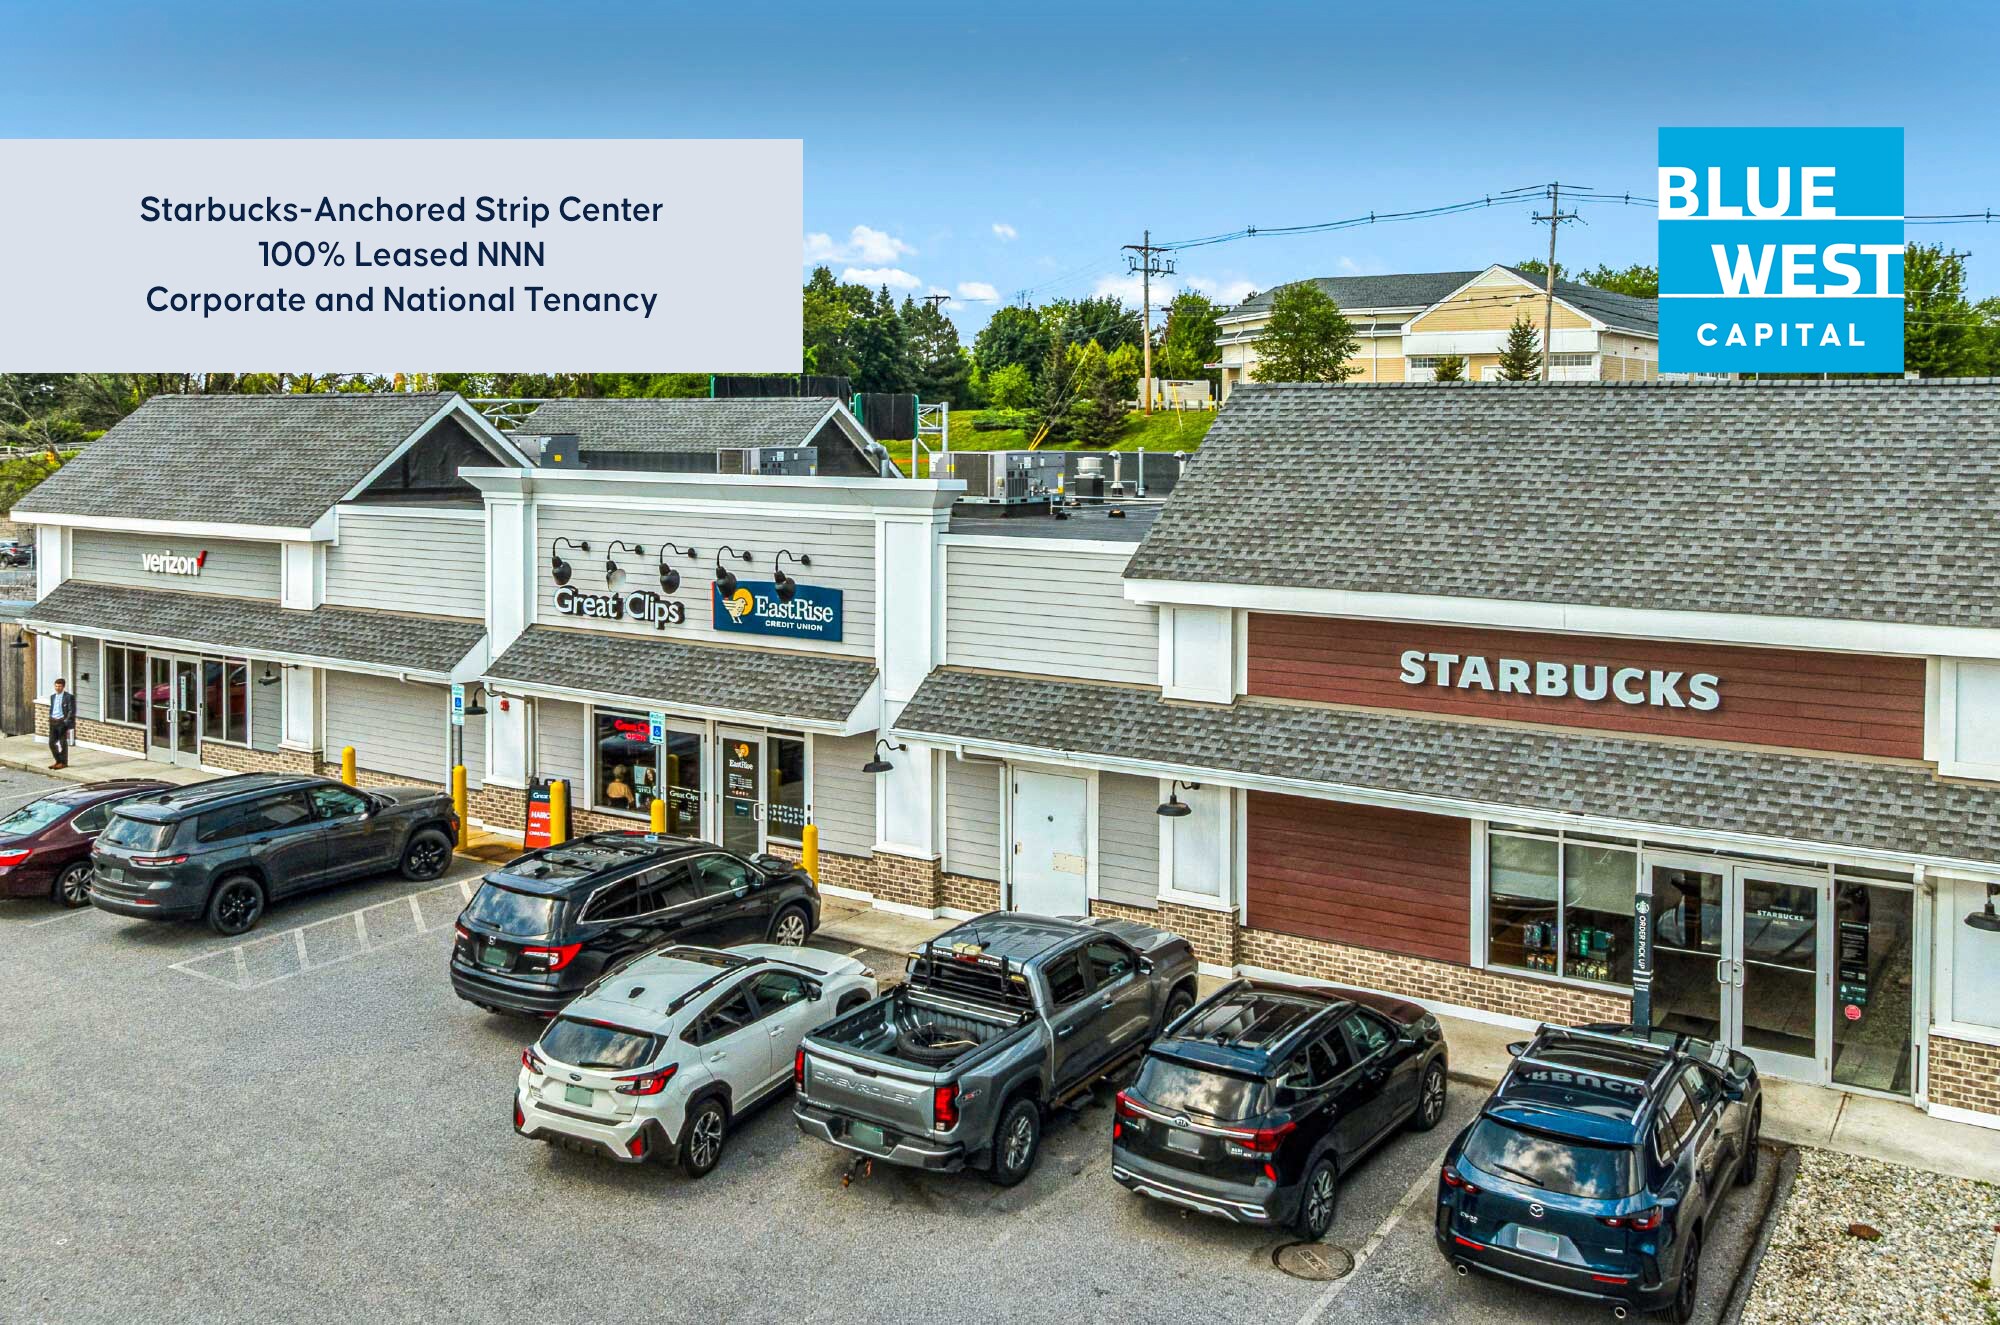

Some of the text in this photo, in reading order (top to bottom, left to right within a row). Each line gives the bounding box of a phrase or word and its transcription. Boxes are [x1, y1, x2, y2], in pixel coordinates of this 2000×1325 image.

[141, 549, 199, 576] verizon
[553, 586, 681, 631] Great Clips
[754, 594, 834, 624] EastRise
[764, 619, 823, 631] CREDIT UNION
[1399, 650, 1720, 711] STARBUCKS
[729, 759, 754, 770] EastRise
[531, 811, 551, 819] HAIRC
[1757, 909, 1804, 921] STARBUCKS
[1638, 915, 1647, 970] ORDER PICK UP
